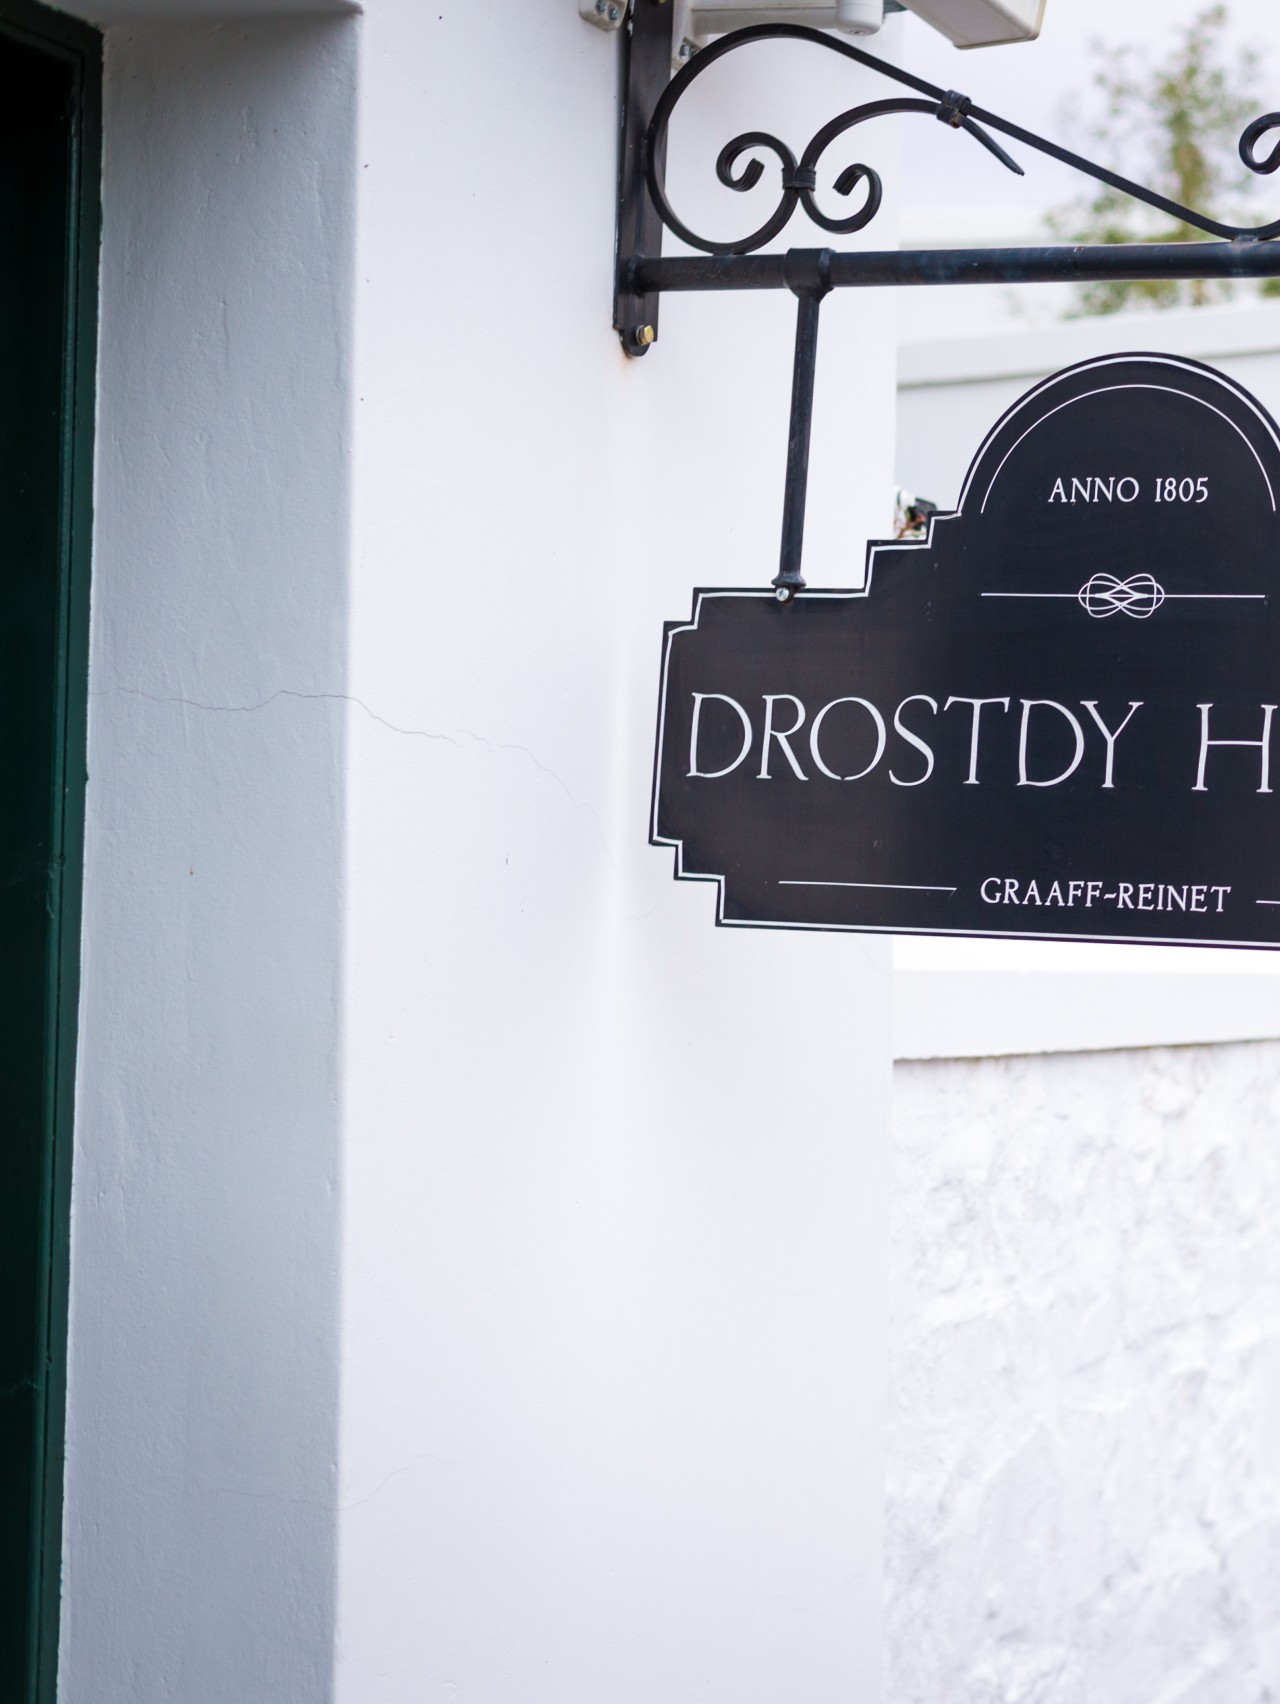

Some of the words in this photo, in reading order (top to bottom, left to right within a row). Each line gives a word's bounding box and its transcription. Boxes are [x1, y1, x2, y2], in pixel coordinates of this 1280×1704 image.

[1047, 476, 1140, 503] ANNO
[1154, 477, 1209, 504] 1805
[685, 691, 1144, 788] DROSTDY
[980, 877, 1232, 913] GRAAFF-REINET
